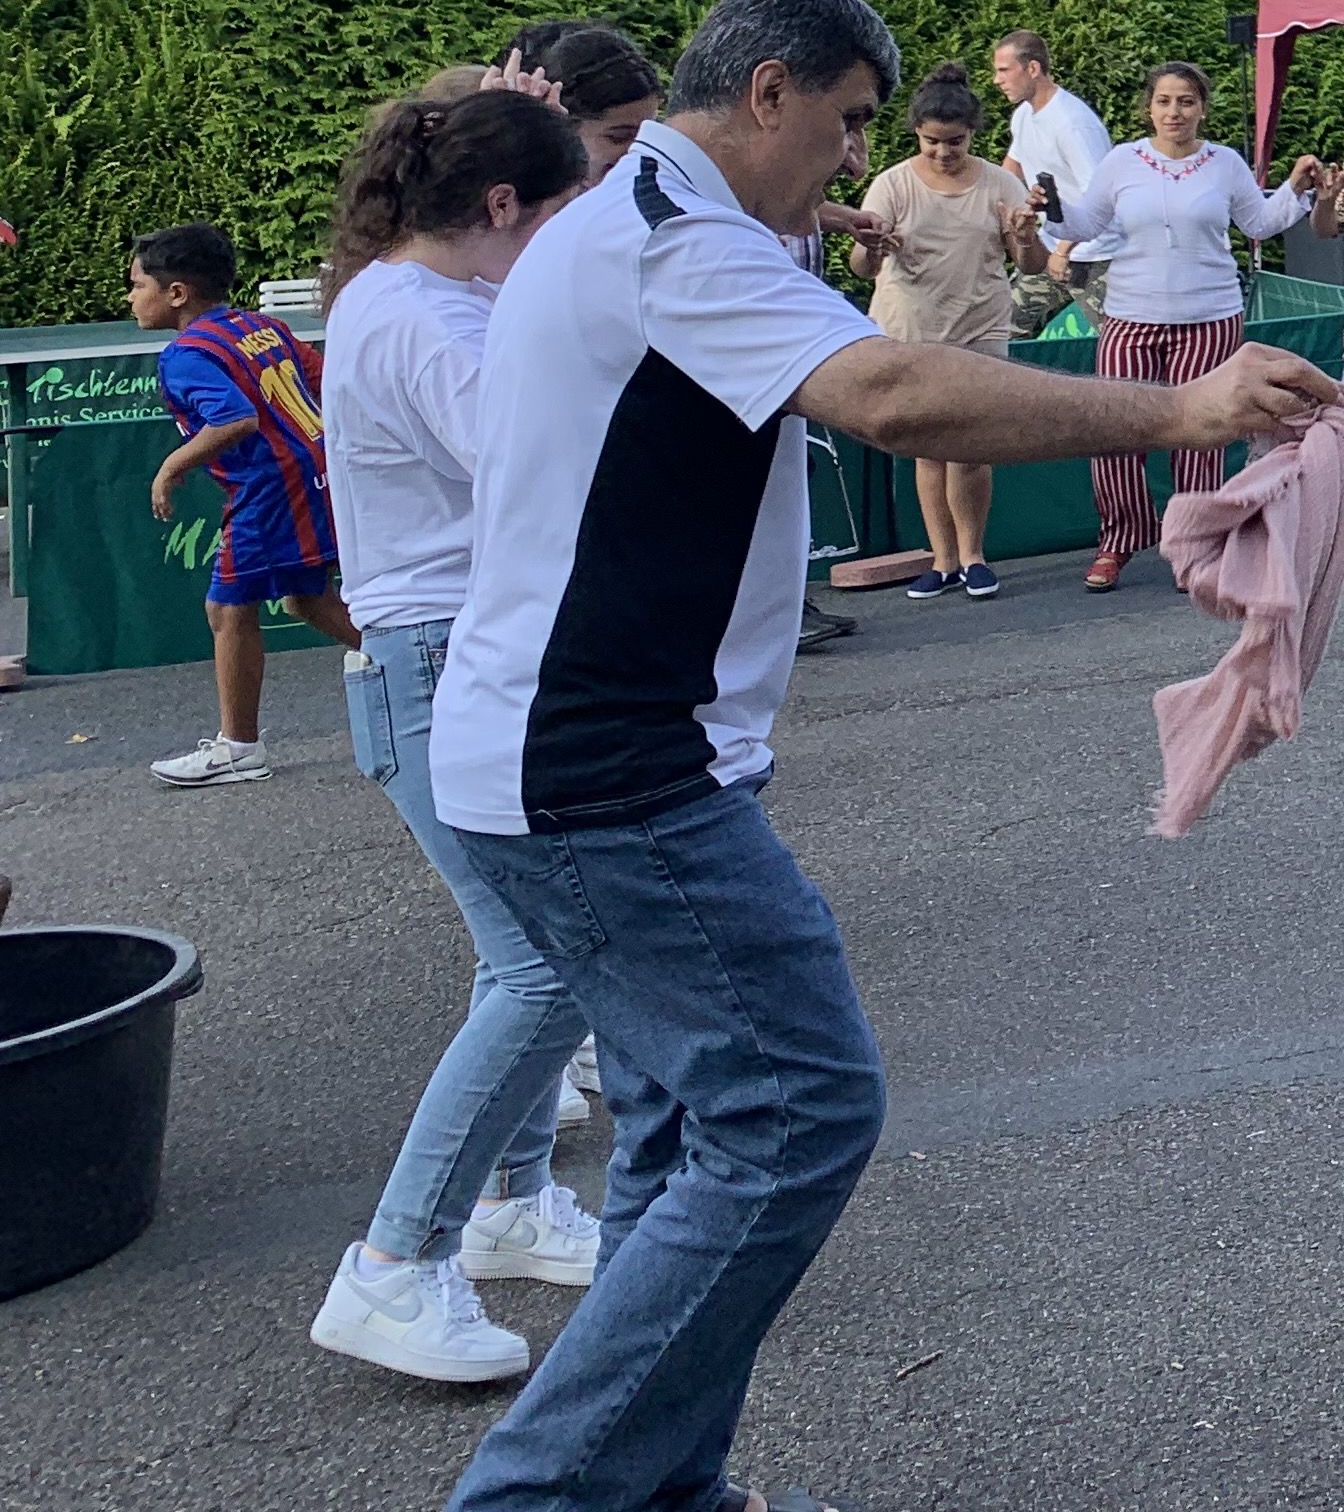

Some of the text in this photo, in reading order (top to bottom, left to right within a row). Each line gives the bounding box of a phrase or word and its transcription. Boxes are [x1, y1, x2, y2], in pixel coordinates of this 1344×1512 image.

[235, 326, 283, 361] MESSI
[26, 366, 158, 404] Tischtenn
[259, 359, 325, 442] 10
[79, 402, 164, 422] Service
